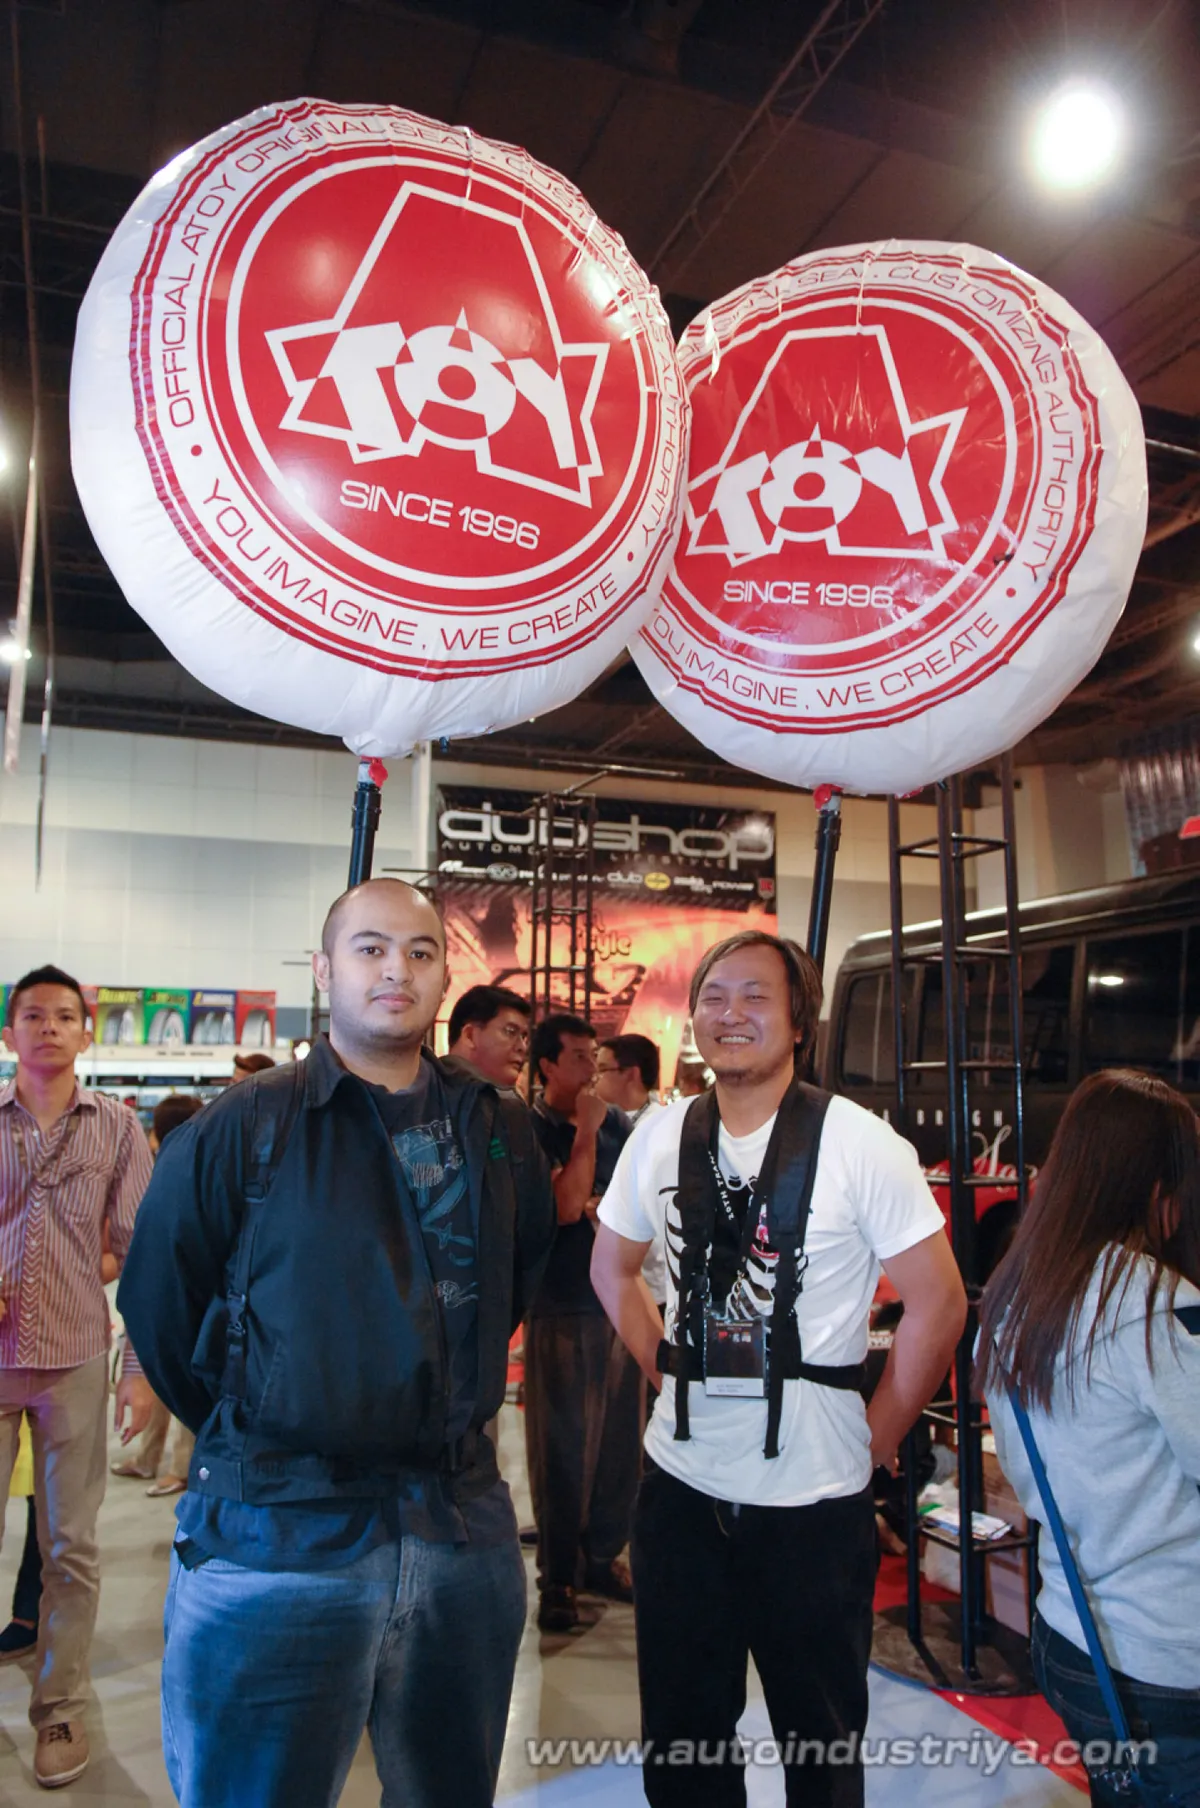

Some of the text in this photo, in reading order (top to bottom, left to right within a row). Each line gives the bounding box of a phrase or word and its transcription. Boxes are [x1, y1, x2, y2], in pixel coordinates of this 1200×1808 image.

[162, 263, 196, 428] OFFICIAL
[180, 173, 236, 256] ATOY
[235, 120, 386, 173] ORIGINAL
[797, 265, 864, 287] SEA
[888, 266, 1058, 384] CUSTOMIZING
[1022, 390, 1074, 582] AUTHORITY
[203, 477, 270, 562] YOU
[440, 626, 499, 651] WE
[508, 572, 618, 645] CREATE
[339, 479, 541, 550] SINCE 1996
[653, 608, 685, 656] OU
[816, 681, 875, 708] WE
[880, 611, 999, 697] CREATE
[723, 579, 894, 609] SINCE 1996
